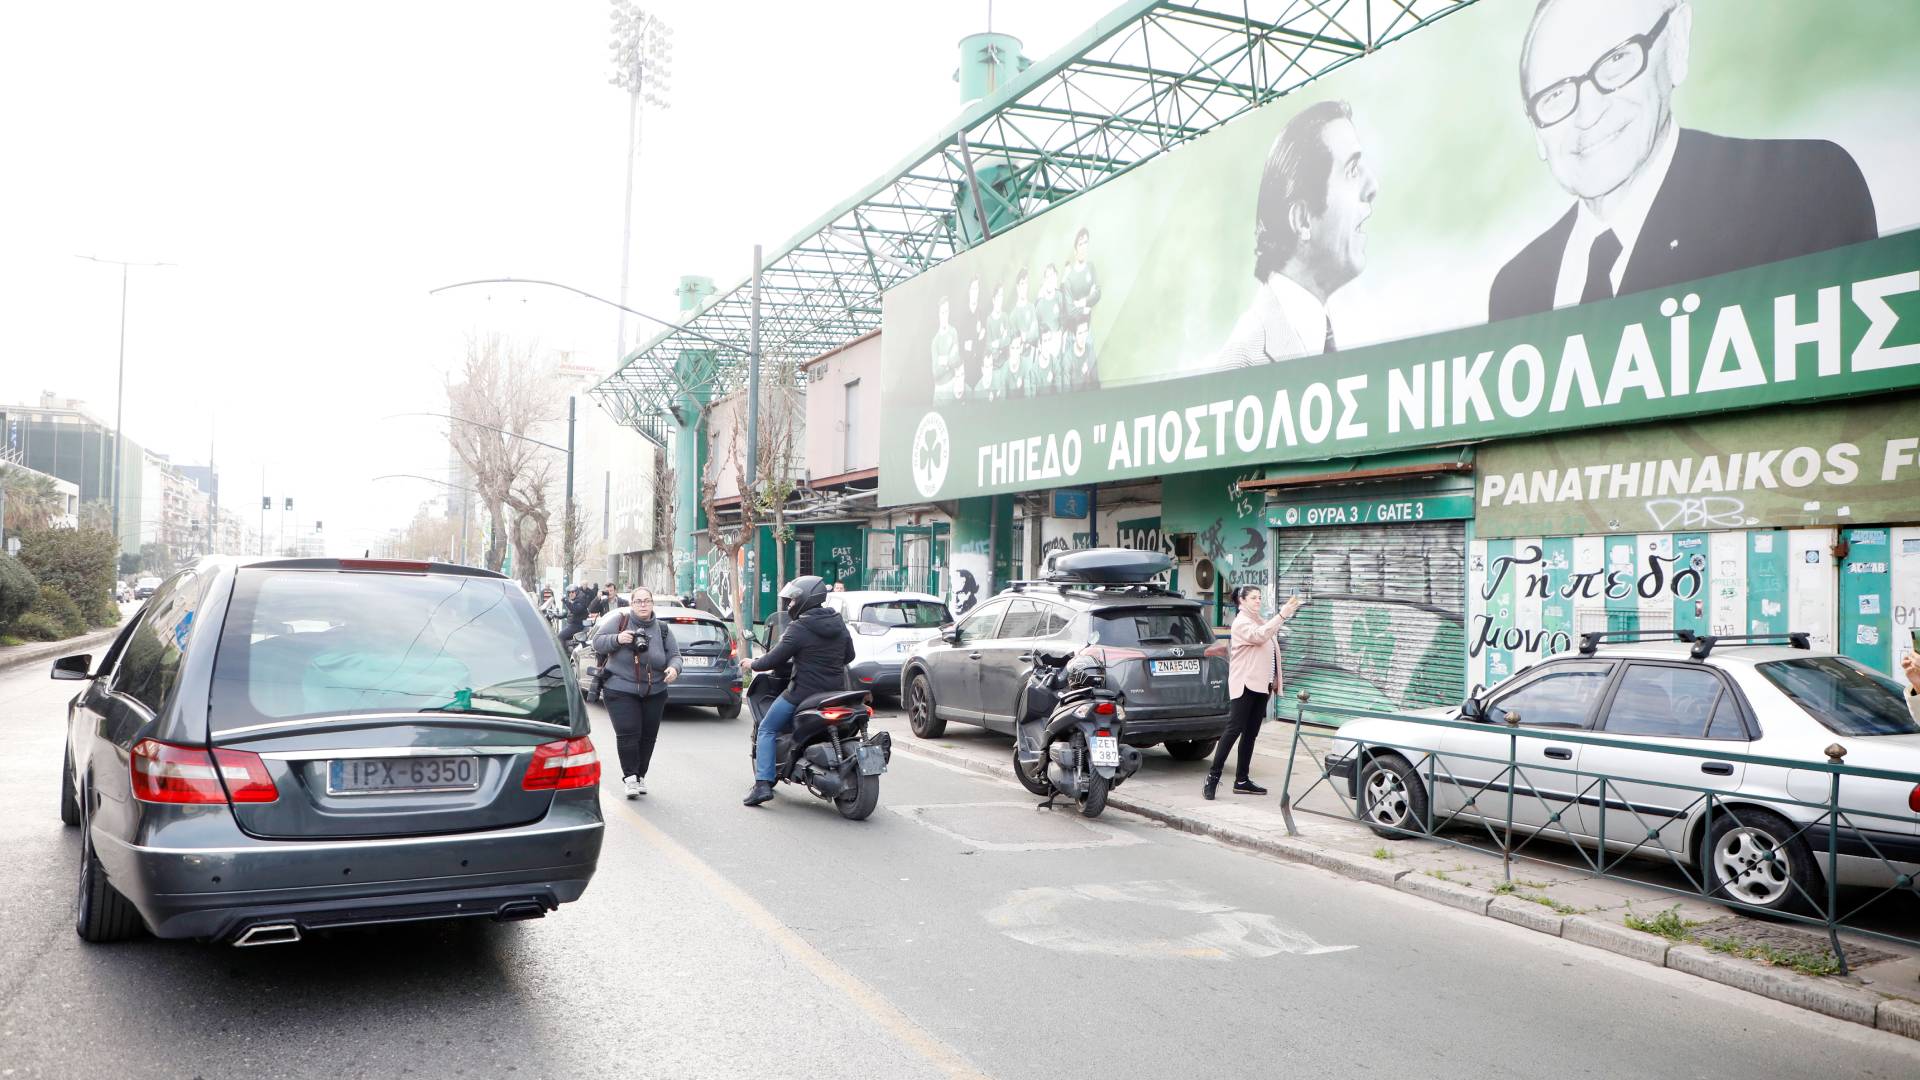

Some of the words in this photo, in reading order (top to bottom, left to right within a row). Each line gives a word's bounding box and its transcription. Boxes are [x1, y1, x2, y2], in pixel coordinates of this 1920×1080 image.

[978, 429, 1082, 488] ΓΗΠΕΔΟ
[1481, 443, 1860, 507] PANATHINAIKOS
[1881, 437, 1920, 481] F
[1307, 507, 1346, 524] ΘΥΡΑ
[1350, 506, 1358, 522] 3
[1377, 502, 1412, 520] GATE
[1415, 502, 1424, 519] 3
[832, 546, 852, 558] EAST
[838, 566, 856, 580] END
[1097, 739, 1116, 749] ZET
[1098, 751, 1118, 760] 387
